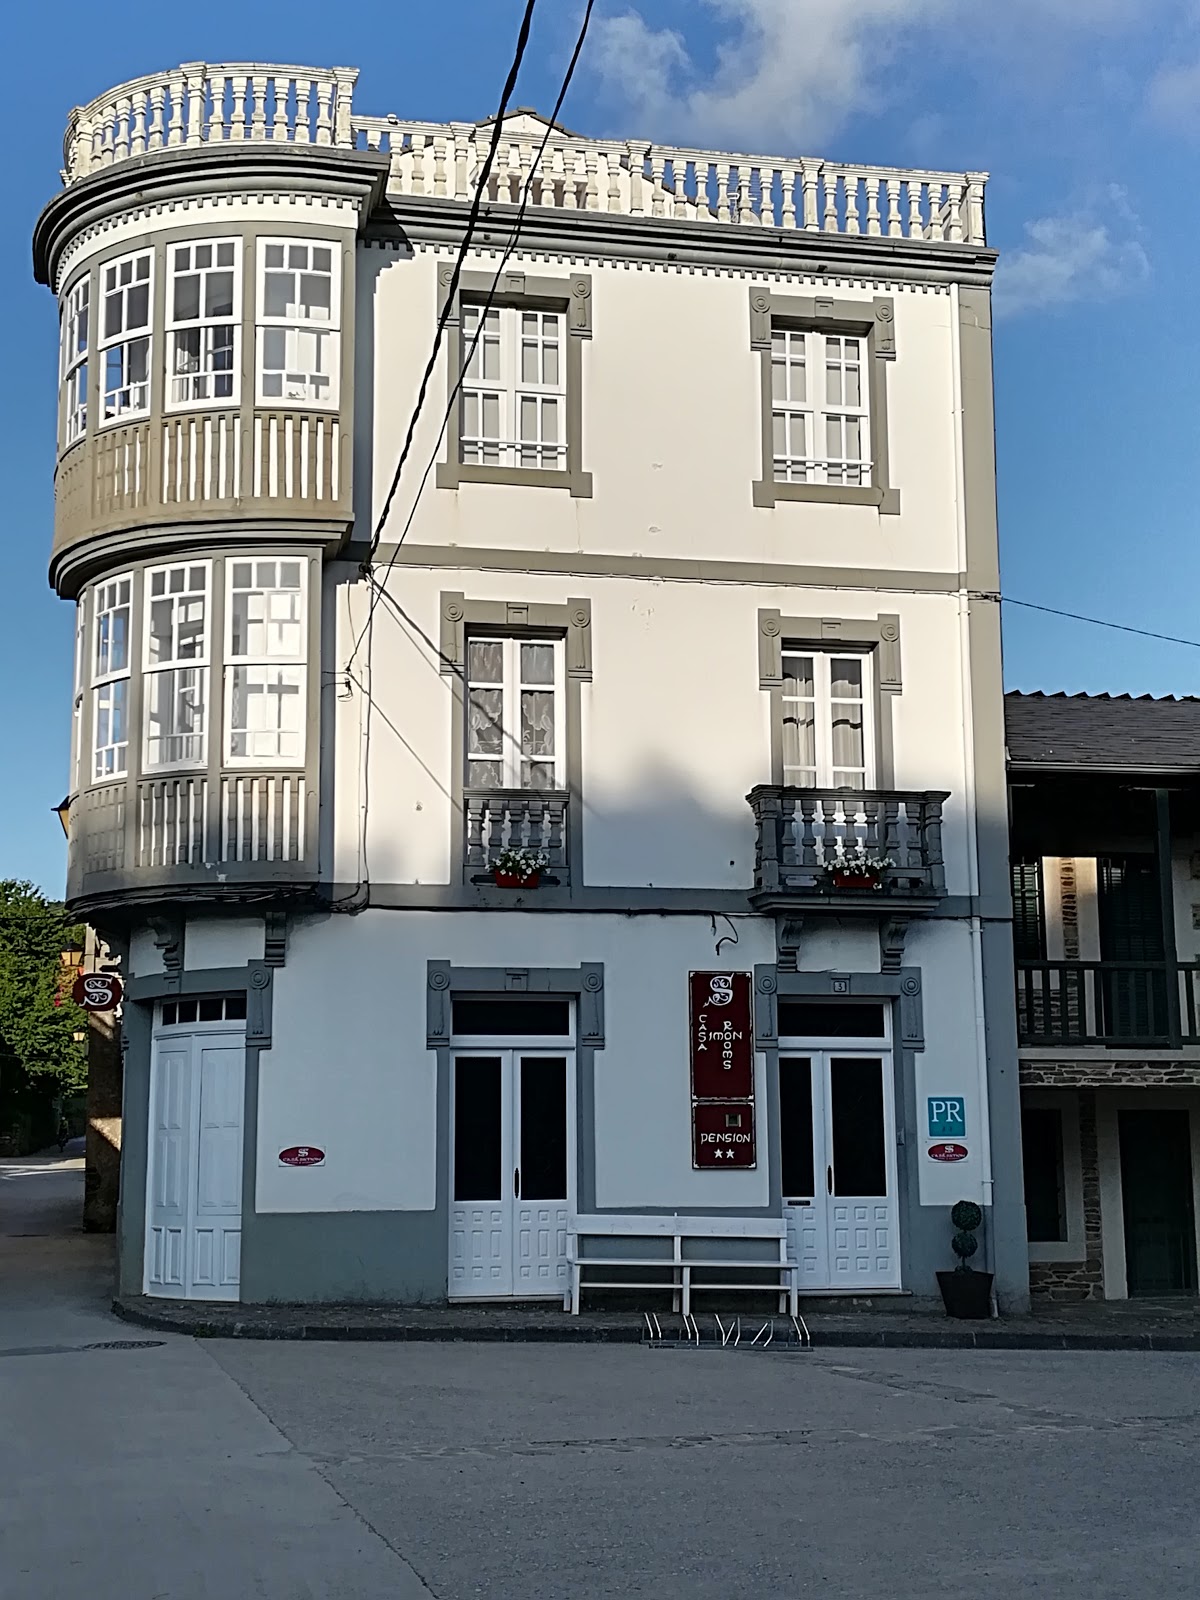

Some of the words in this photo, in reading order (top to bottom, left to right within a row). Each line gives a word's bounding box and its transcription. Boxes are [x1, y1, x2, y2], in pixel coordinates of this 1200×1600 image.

[697, 1014, 708, 1051] CASA
[722, 1021, 733, 1069] ROOMS
[931, 1101, 962, 1122] PR
[700, 1132, 751, 1145] PENSION
